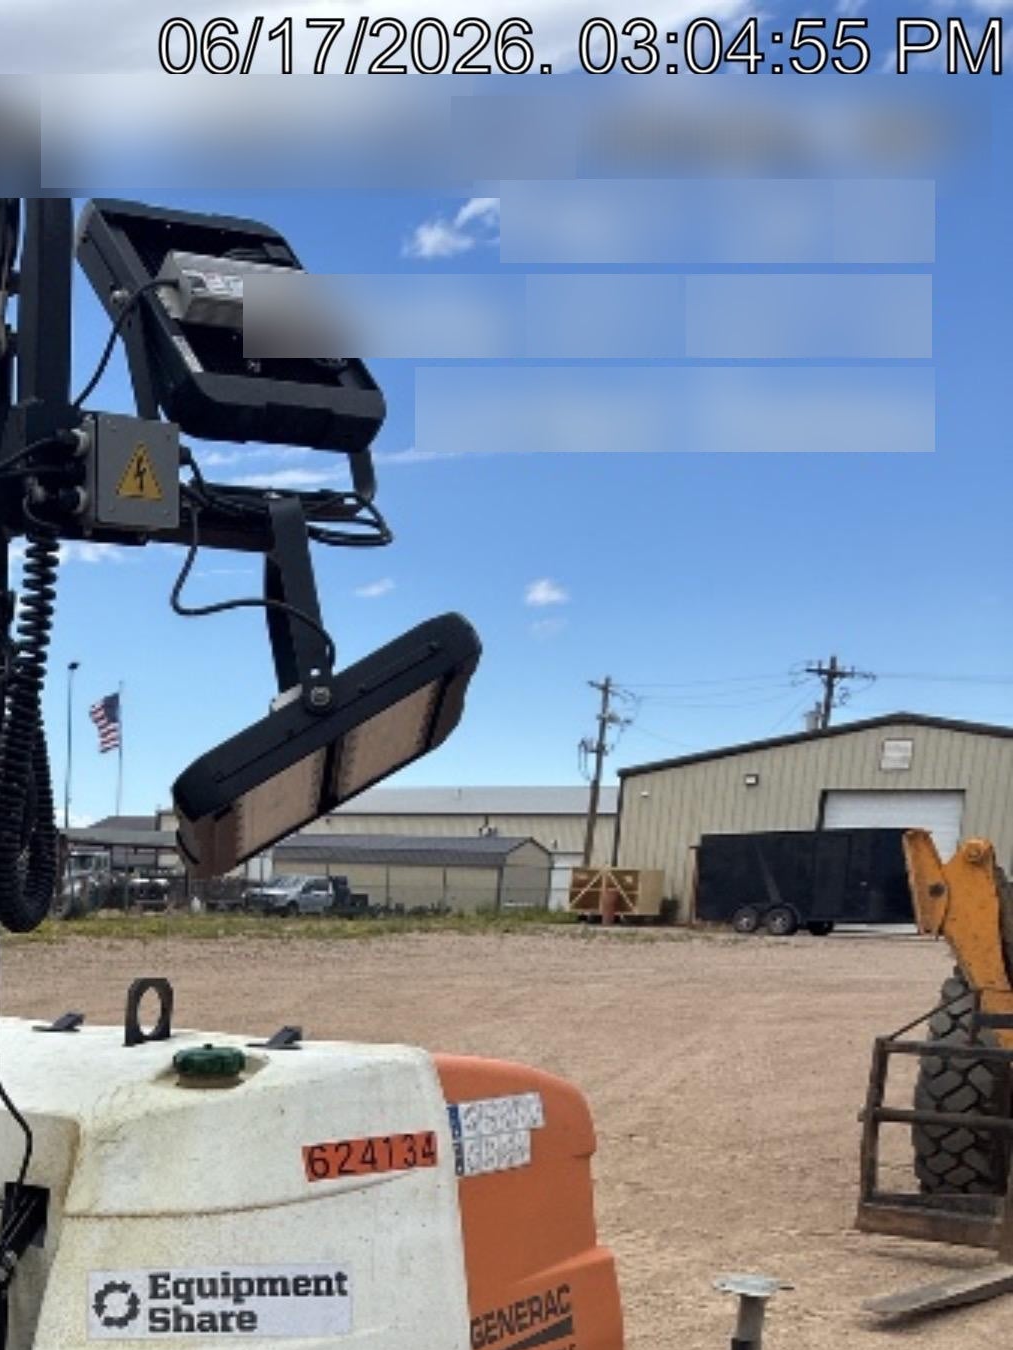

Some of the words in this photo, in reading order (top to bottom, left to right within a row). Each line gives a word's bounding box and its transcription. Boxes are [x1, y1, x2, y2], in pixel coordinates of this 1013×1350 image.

[307, 1131, 436, 1179] 624134
[148, 1271, 348, 1305] Equipment
[148, 1307, 258, 1333] Share
[470, 1283, 572, 1350] GENERAC
